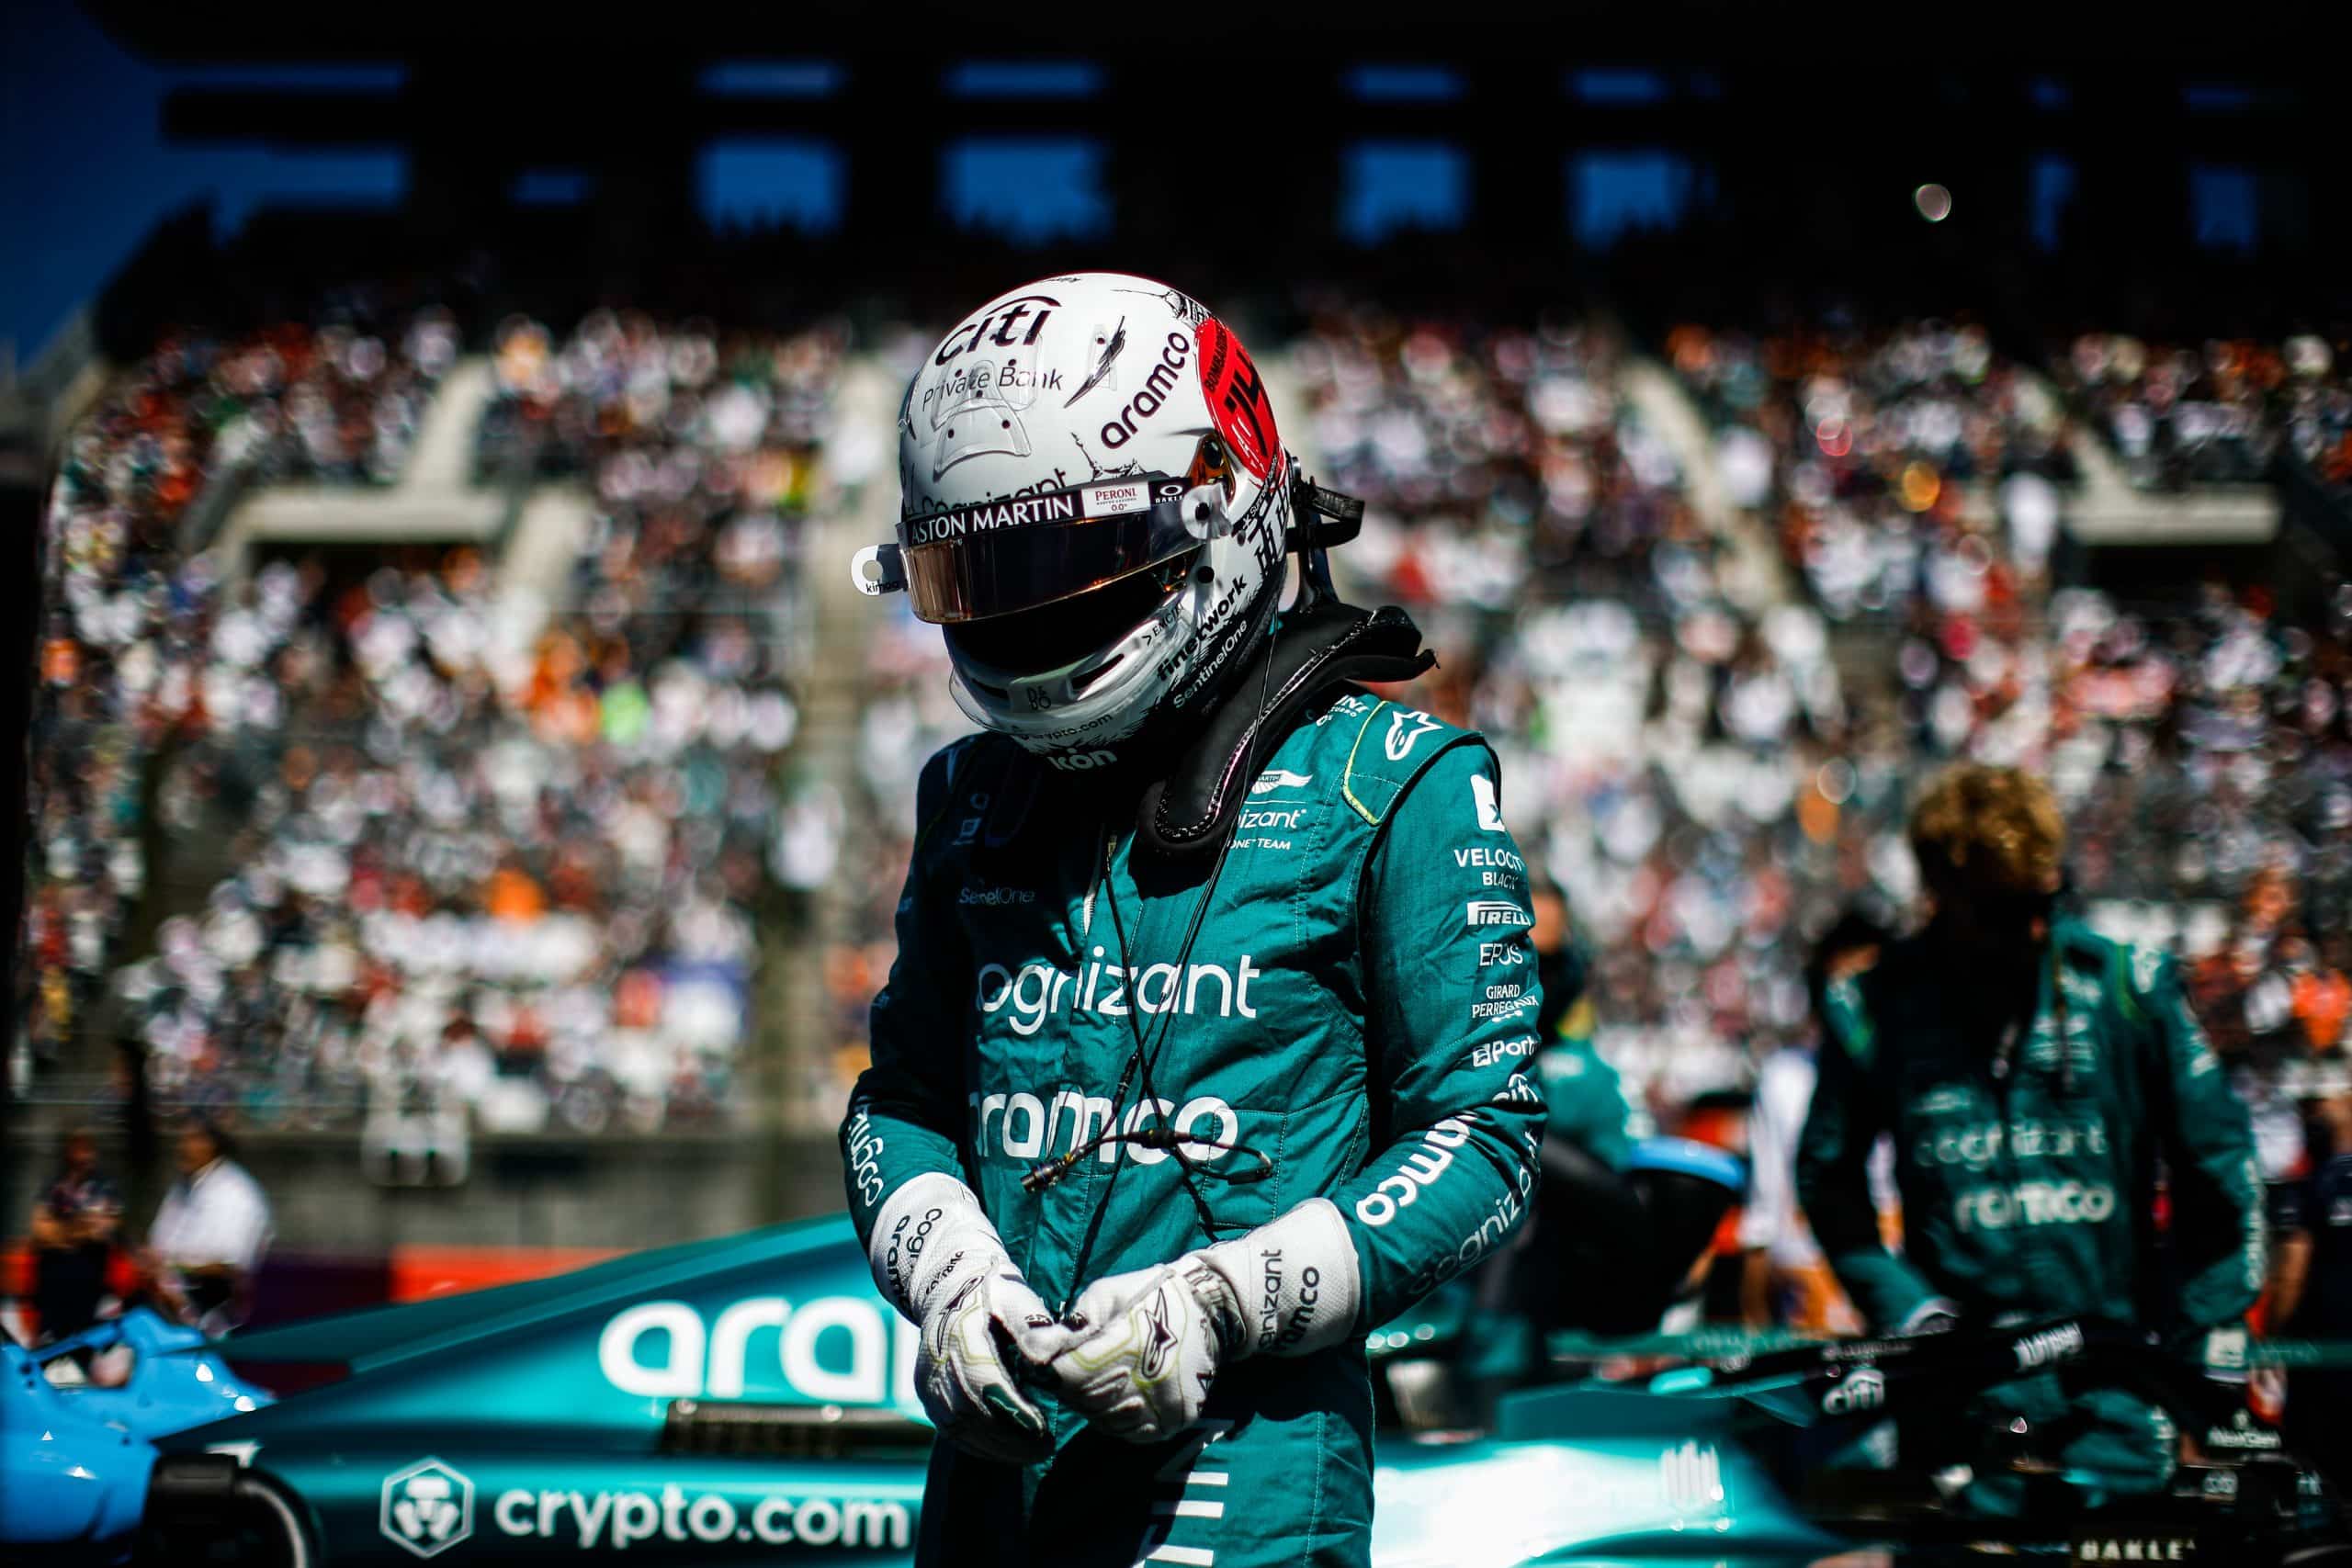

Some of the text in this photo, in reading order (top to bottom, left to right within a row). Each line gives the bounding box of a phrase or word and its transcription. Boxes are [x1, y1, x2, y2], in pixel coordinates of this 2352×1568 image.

[999, 367, 1061, 390] Bank
[1101, 332, 1190, 449] aramco
[911, 494, 1073, 544] ASTON MARTIN
[1095, 487, 1137, 502] PERONI
[1157, 575, 1247, 681] finetwork
[1173, 619, 1248, 708] SentinelOne
[1238, 808, 1301, 829] izant
[1257, 838, 1291, 850] TEAM
[1482, 871, 1519, 890] BLACK
[978, 945, 1261, 1036] ognizant
[1486, 984, 1521, 999] GIRARD
[1356, 1112, 1475, 1226] amco
[598, 1296, 922, 1404] ara
[493, 1483, 910, 1551] crypto.com
